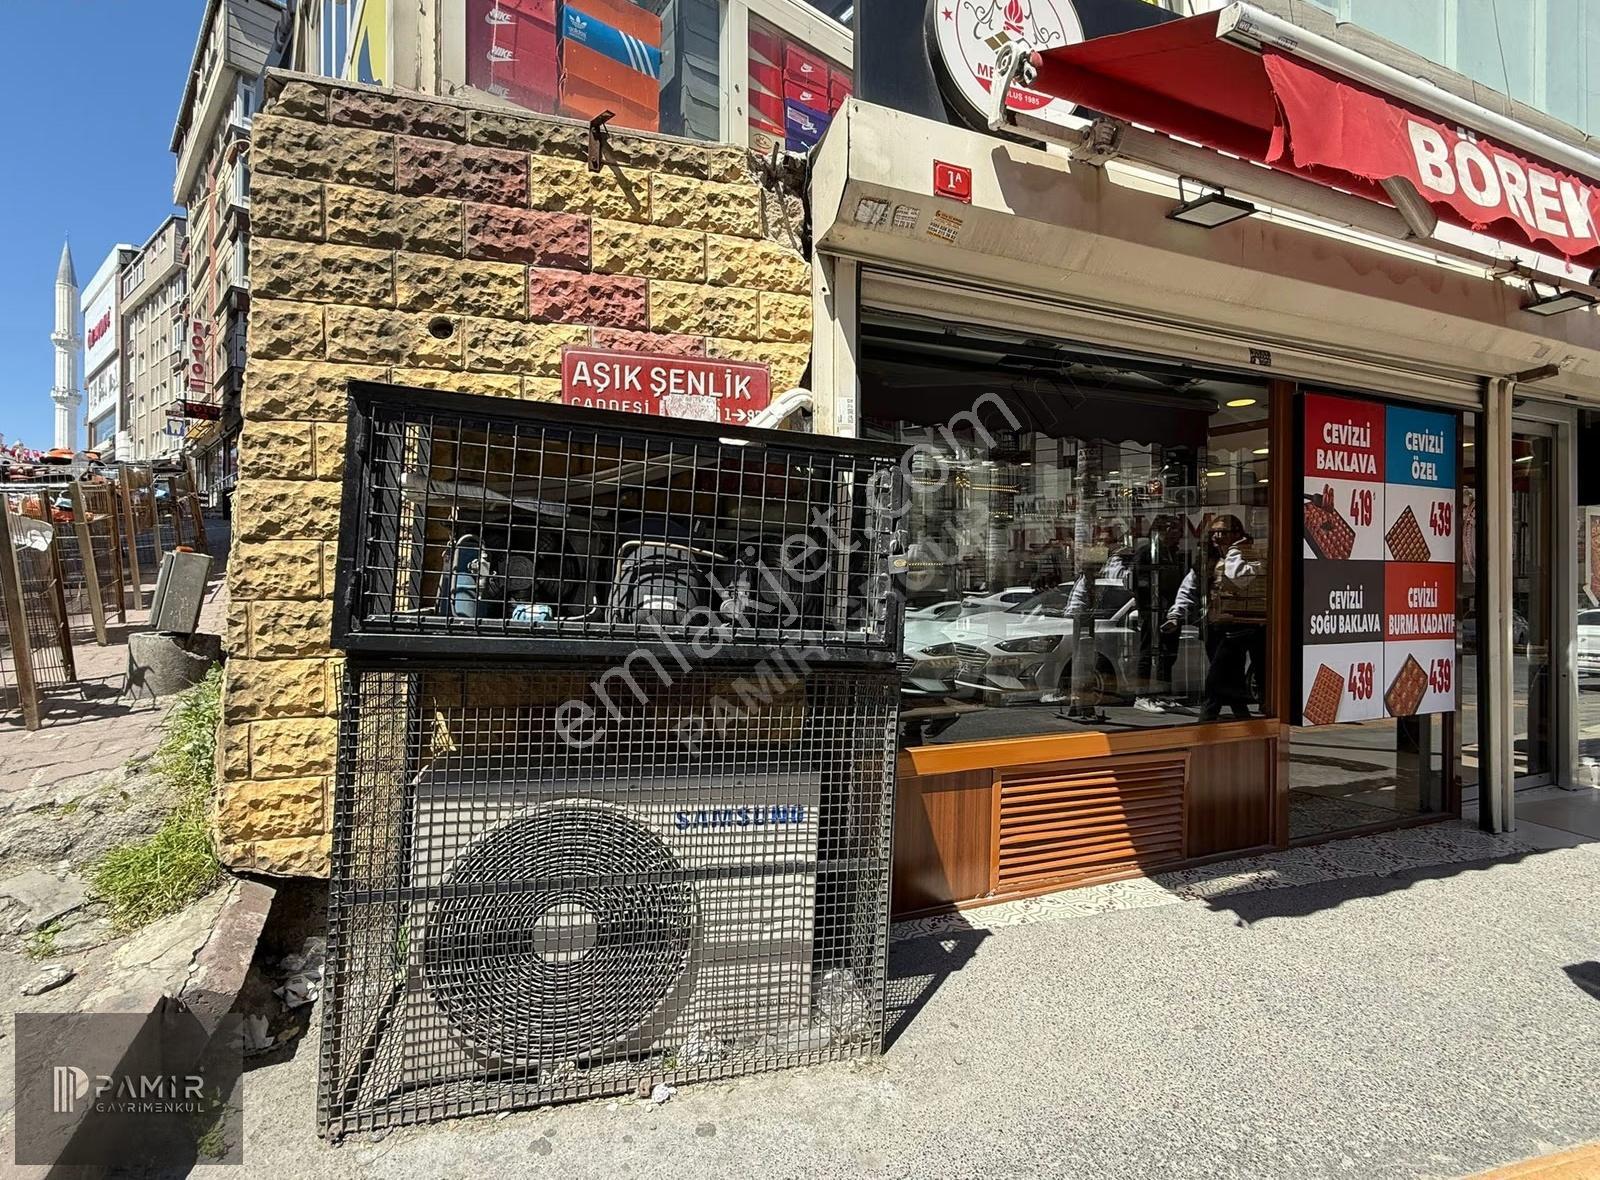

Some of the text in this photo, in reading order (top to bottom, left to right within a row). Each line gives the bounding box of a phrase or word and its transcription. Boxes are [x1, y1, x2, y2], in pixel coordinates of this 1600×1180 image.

[489, 8, 512, 21] NIKE
[492, 46, 513, 59] NIKE
[1024, 95, 1040, 105] 1985
[947, 171, 962, 189] 1A
[572, 361, 751, 400] AŞIK ŞENLİK
[1323, 419, 1370, 448] CEVİZLİ
[1405, 429, 1444, 454] CEVİZLİ
[1316, 448, 1377, 474] BAKLAVA
[1412, 456, 1438, 480] ÖZEL
[1350, 488, 1373, 527] 419
[1429, 501, 1452, 537] 439
[1329, 584, 1363, 610] CEVİZLİ
[1408, 581, 1438, 609] CEVİZLİ
[1310, 610, 1381, 635] SOĞU BAKLAVA
[1388, 613, 1455, 635] BURMA KADAYIF
[1348, 662, 1373, 700] 439
[1429, 658, 1452, 693] 439
[675, 804, 804, 831] SAMSUNG
